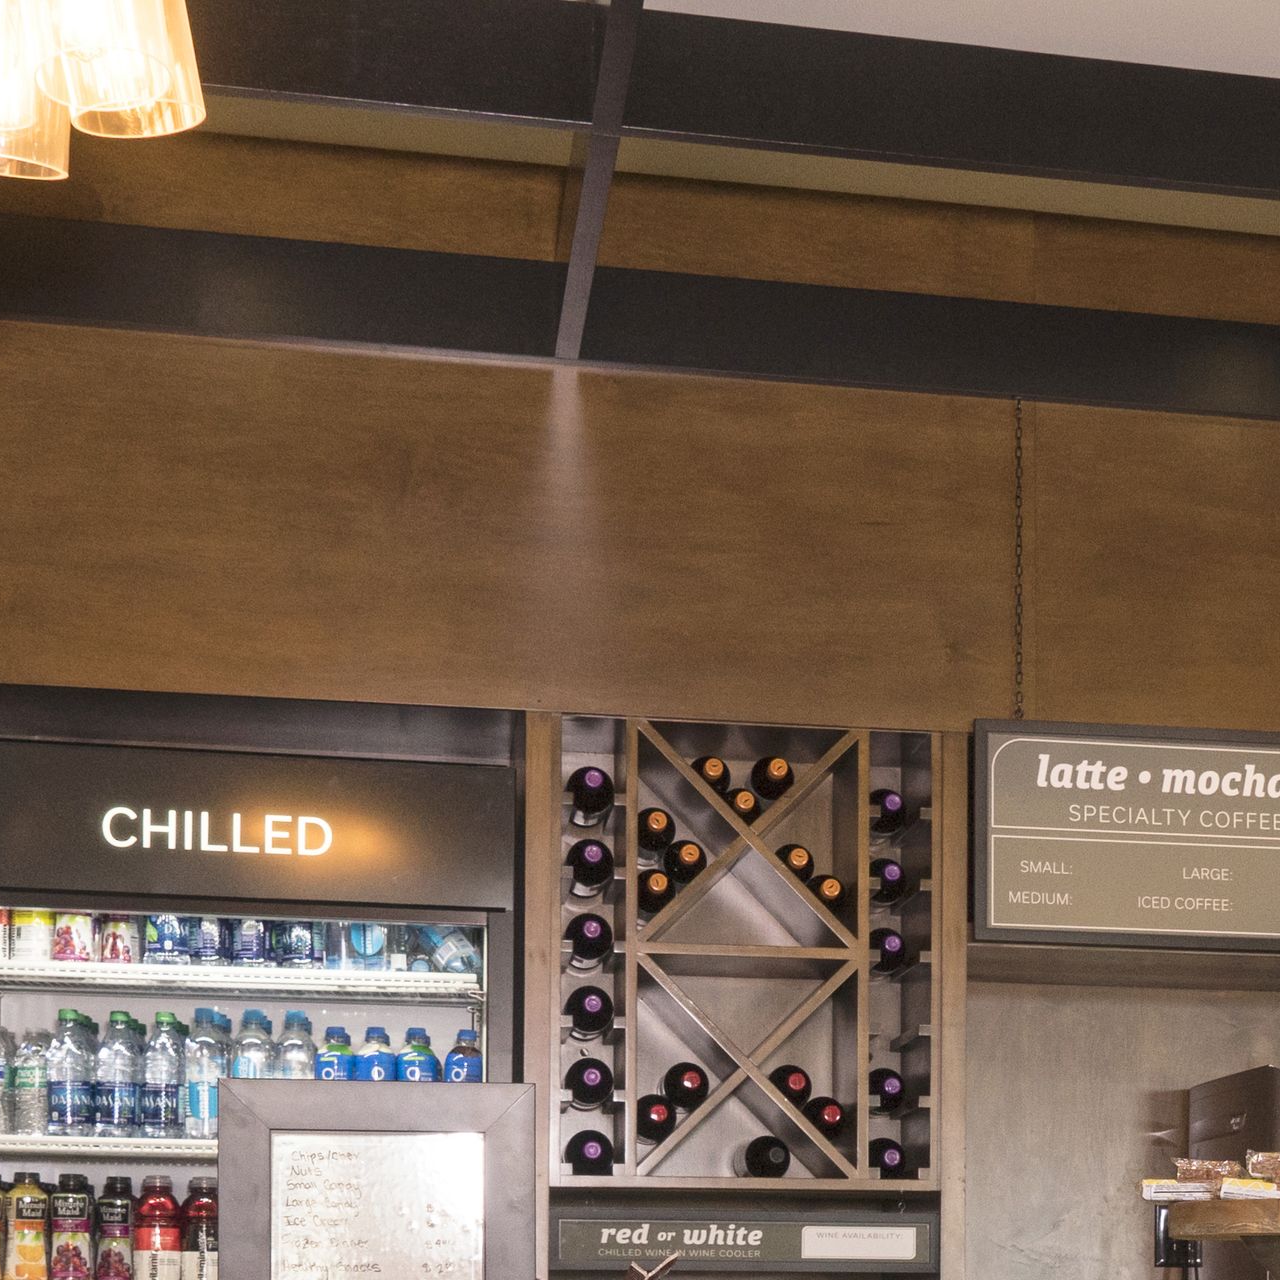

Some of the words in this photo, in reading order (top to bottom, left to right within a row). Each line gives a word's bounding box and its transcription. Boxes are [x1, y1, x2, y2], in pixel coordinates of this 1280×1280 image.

[1035, 754, 1128, 792] latte
[1068, 804, 1193, 828] SPECIALTY
[101, 806, 334, 857] CHILLED
[1019, 859, 1073, 875] SMALL:
[1182, 866, 1234, 882] LARGE:
[1008, 890, 1073, 907] MEDIUM:
[1137, 896, 1170, 910] ICED
[1174, 897, 1234, 912] COFFEE:
[600, 1224, 649, 1245] red
[657, 1230, 676, 1242] or
[683, 1224, 763, 1246] white
[816, 1231, 840, 1240] WINE
[598, 1247, 642, 1257] CHILLED
[645, 1248, 673, 1257] WINE
[689, 1248, 717, 1258] WINE
[719, 1248, 761, 1258] COOLER
